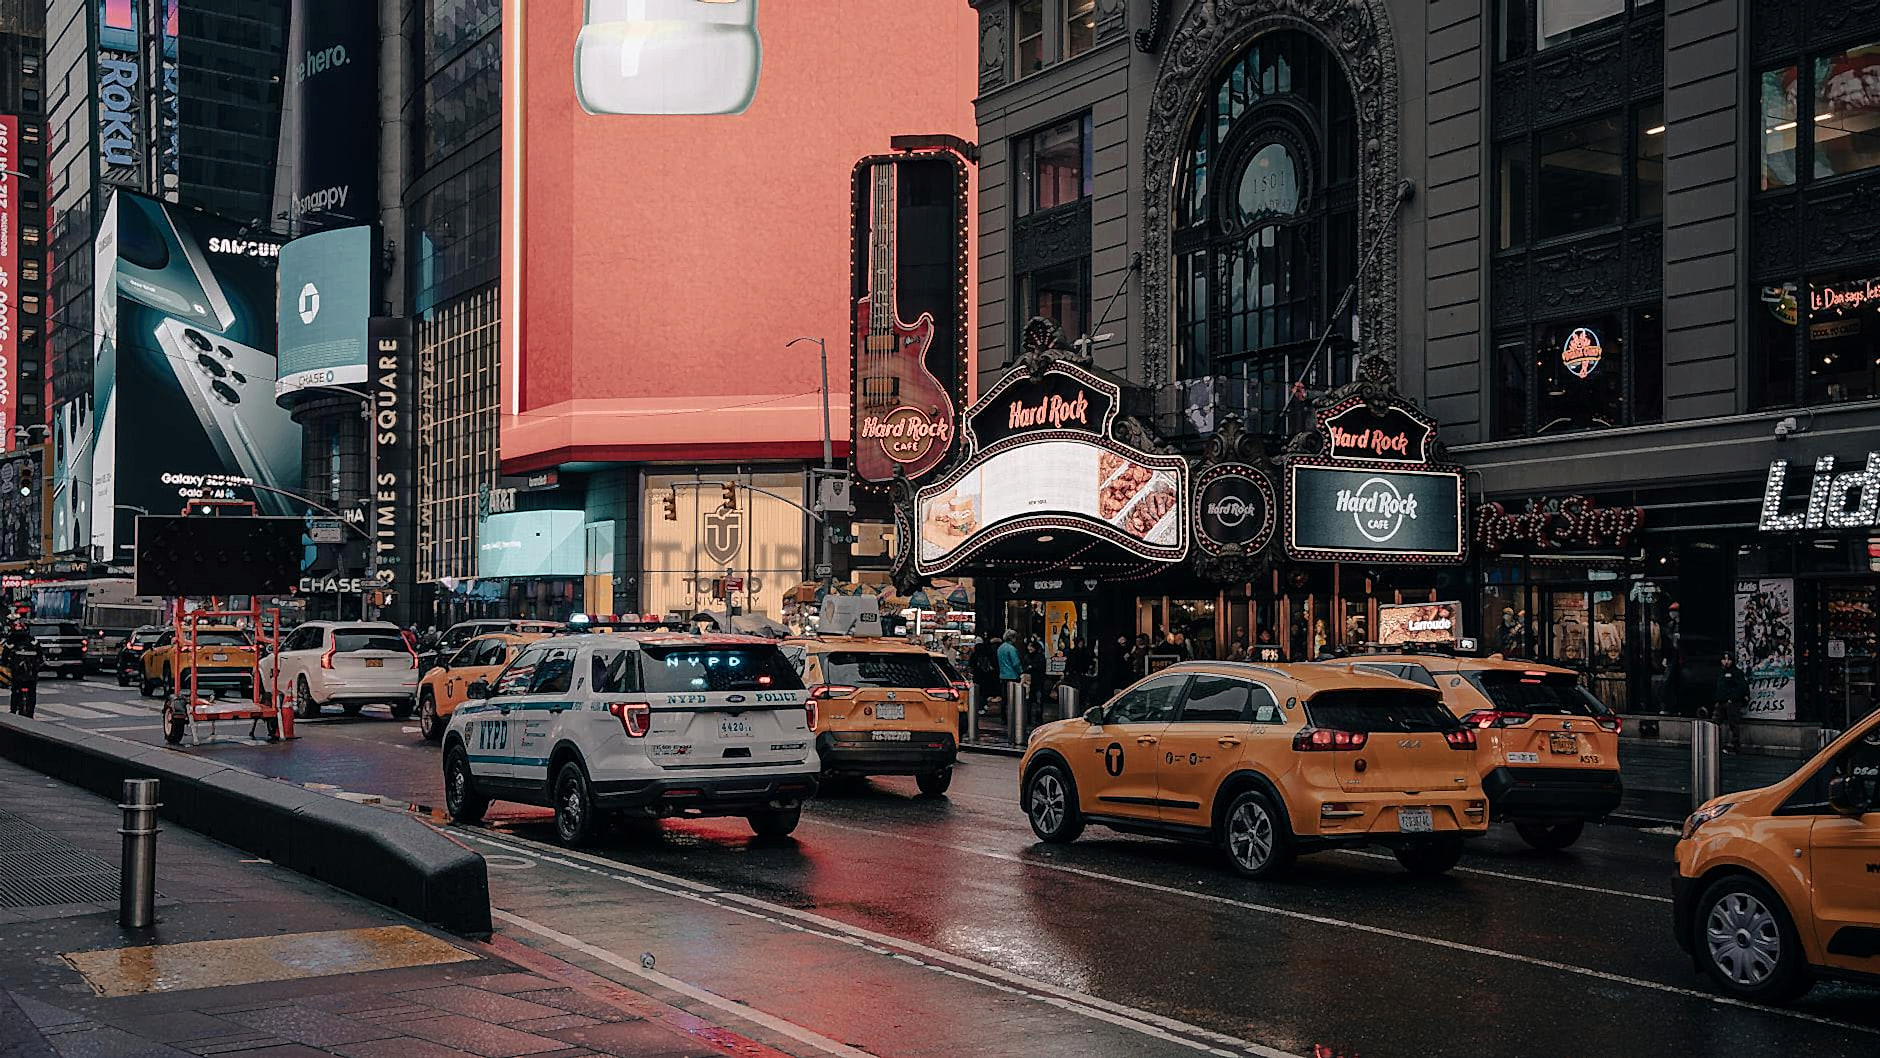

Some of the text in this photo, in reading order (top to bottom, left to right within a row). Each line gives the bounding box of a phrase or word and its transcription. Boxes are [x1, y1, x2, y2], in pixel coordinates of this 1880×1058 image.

[306, 44, 351, 77] hero.
[1253, 170, 1285, 194] 1501
[378, 339, 398, 445] SQUARE
[1008, 389, 1089, 429] Hard Rock
[861, 416, 949, 441] Hard Rock
[1331, 426, 1409, 456] Hard Rock
[161, 472, 204, 487] Galaxy
[1759, 450, 1880, 531] Lid
[376, 473, 396, 553] TIMES
[489, 488, 517, 513] AT&T
[1207, 501, 1256, 517] Hard Rock
[1335, 489, 1419, 520] Hard Rock
[1367, 519, 1391, 530] CAFE
[1554, 496, 1643, 548] Shop
[300, 577, 362, 593] CHASE
[682, 577, 762, 593] TOO
[666, 656, 741, 668] NYPD
[667, 695, 706, 704] NYPD
[756, 693, 798, 702] POLICE
[1748, 699, 1786, 712] CLASS
